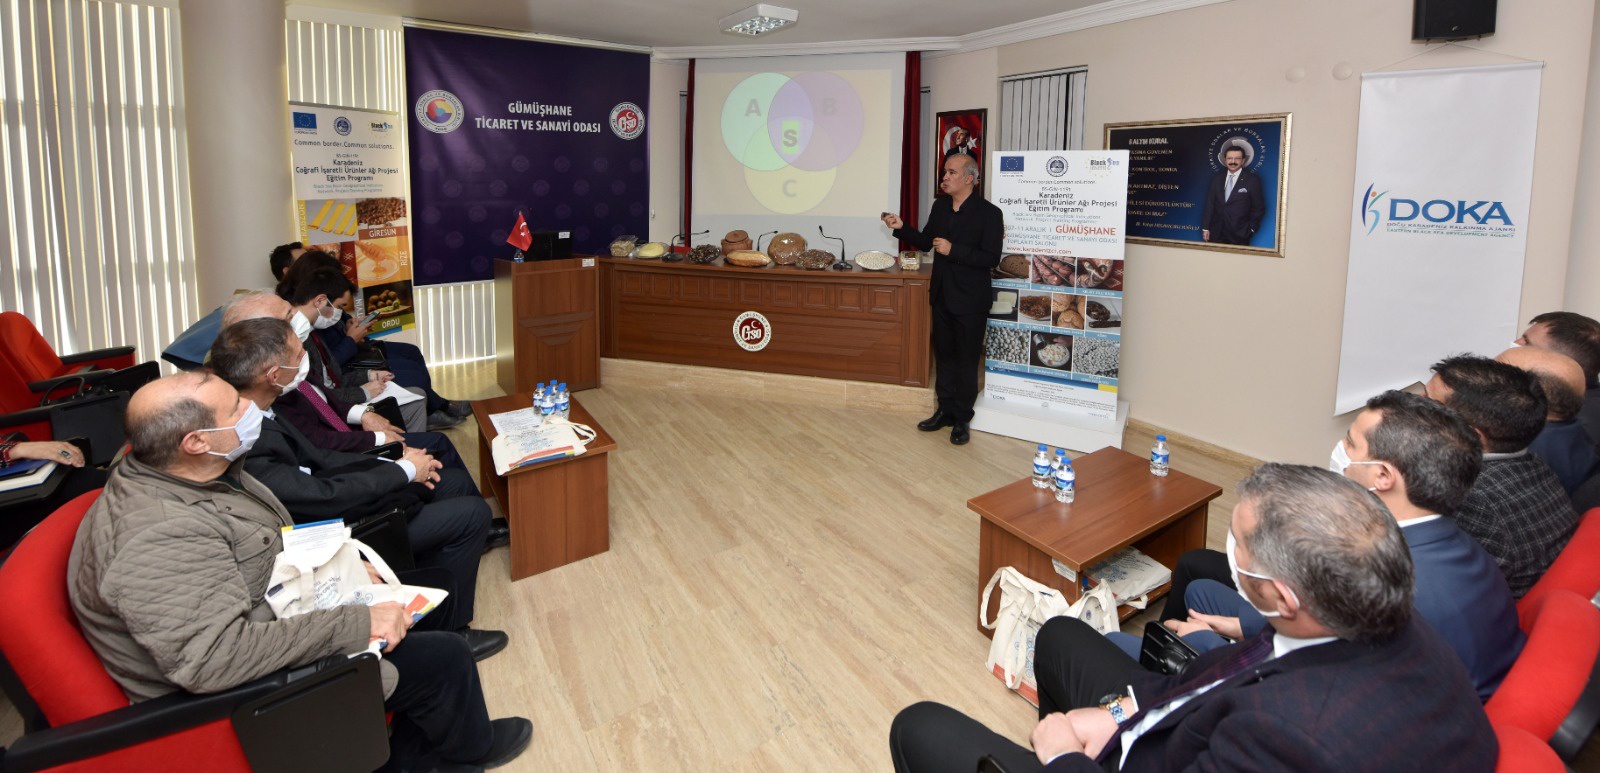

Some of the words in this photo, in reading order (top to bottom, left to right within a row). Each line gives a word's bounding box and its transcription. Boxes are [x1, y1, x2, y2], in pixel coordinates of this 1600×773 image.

[508, 102, 572, 117] GÜMÜŞHANE
[744, 98, 762, 117] A
[823, 98, 838, 116] B
[475, 116, 518, 130] TİCARET
[521, 119, 534, 131] VE
[536, 118, 571, 132] SANAYİ
[573, 122, 601, 133] ODASI
[783, 129, 798, 147] S
[295, 166, 320, 174] Coğrafi
[320, 165, 343, 174] İşaretli
[344, 165, 367, 173] Ürünler
[326, 174, 346, 182] Eğitim
[782, 179, 797, 198] C
[999, 197, 1022, 205] Coğrafi
[1091, 200, 1118, 208] Projesi
[1028, 205, 1050, 213] Eğitim
[1388, 198, 1515, 226] DOKA
[369, 228, 397, 238] GİRESUN
[1055, 224, 1117, 236] GÜMÜŞHANE
[400, 250, 408, 266] RİZE
[381, 318, 400, 329] ORDU
